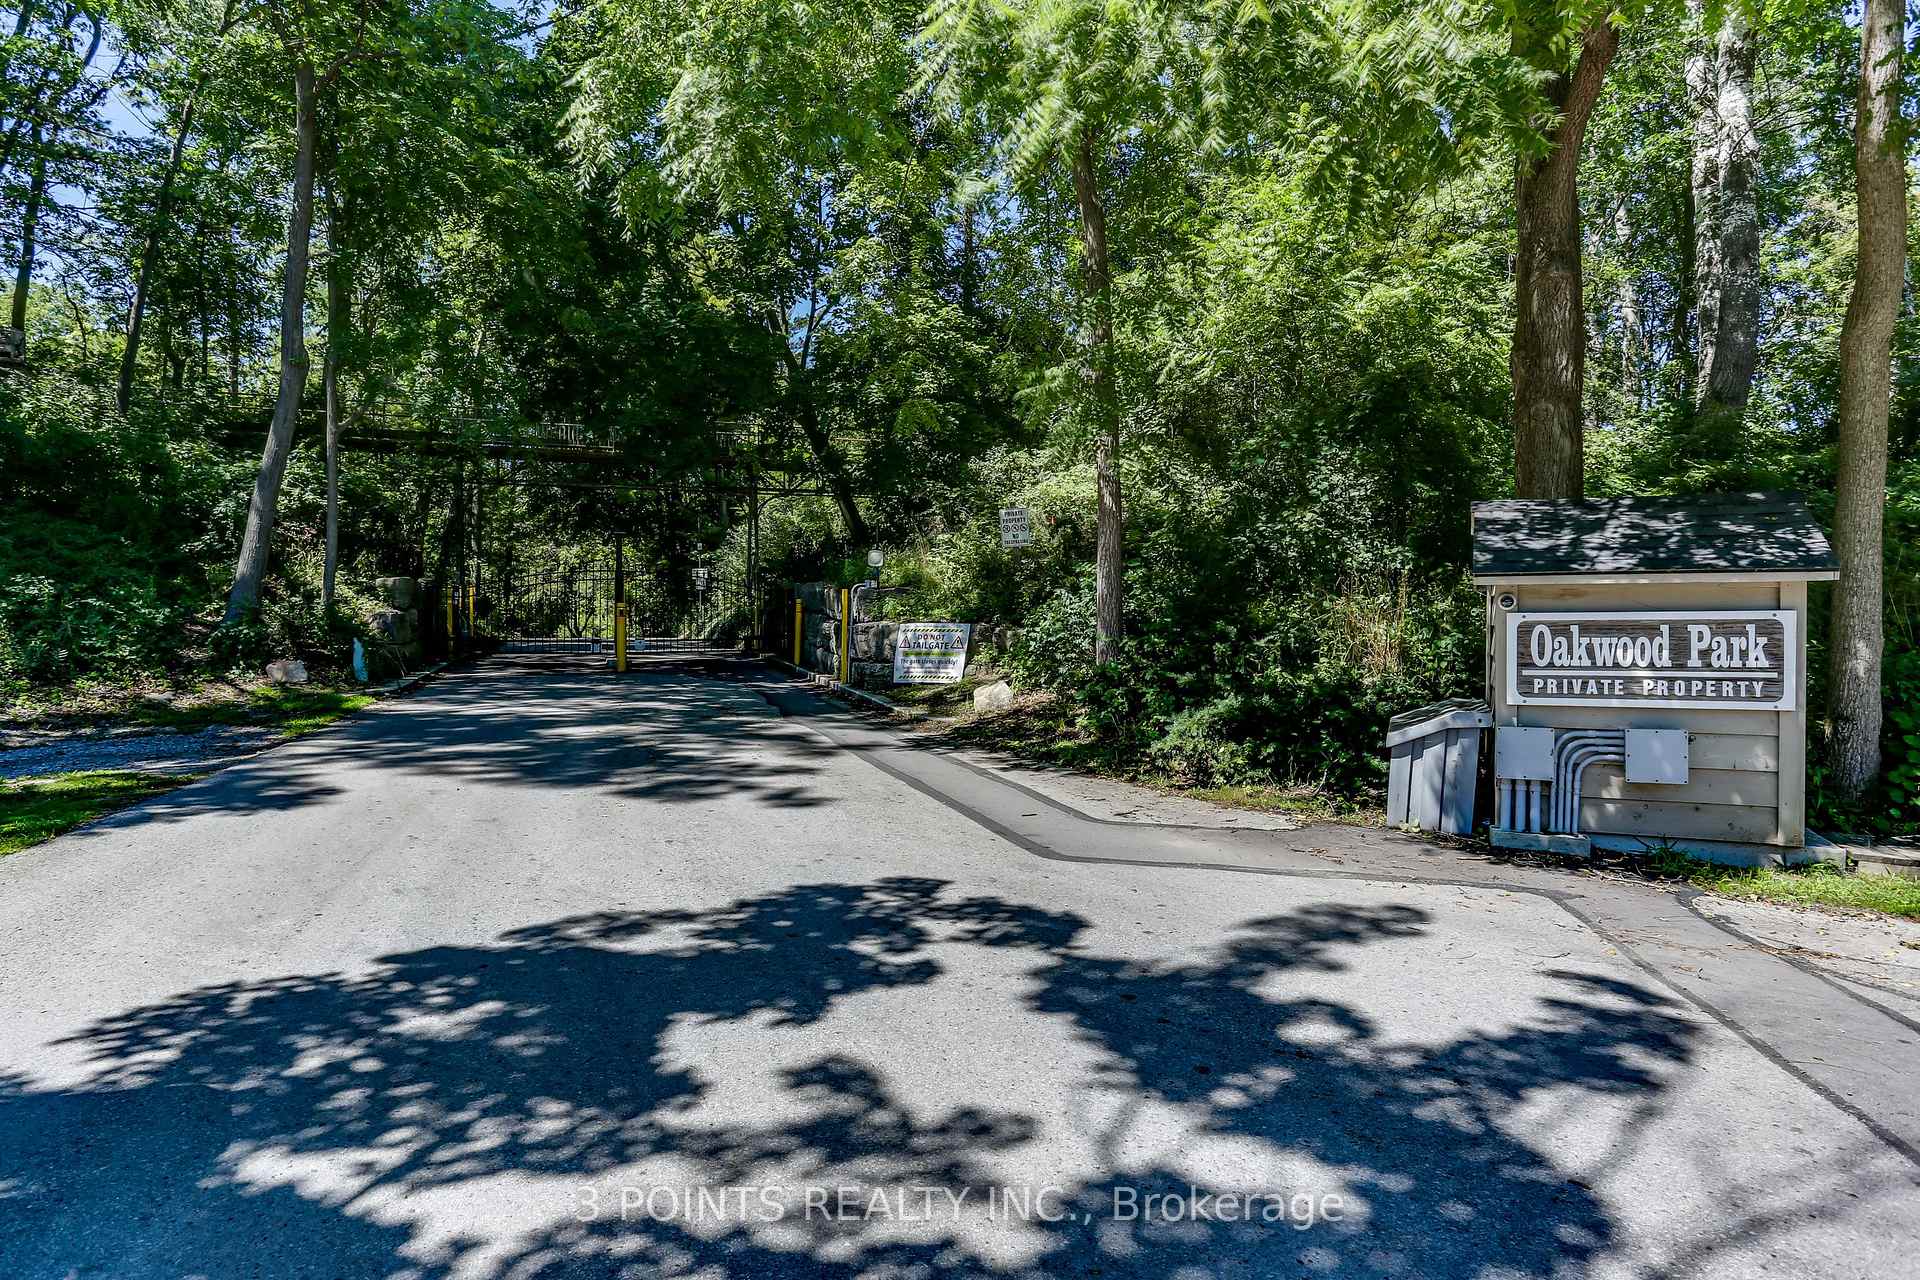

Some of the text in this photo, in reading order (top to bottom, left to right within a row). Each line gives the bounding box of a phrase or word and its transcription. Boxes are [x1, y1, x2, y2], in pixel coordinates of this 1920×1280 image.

[929, 633, 945, 641] NOT
[912, 641, 951, 650] TAILGATE
[1530, 624, 1770, 668] Oakwood Park
[1533, 678, 1765, 698] PRIVATE PROPERTY
